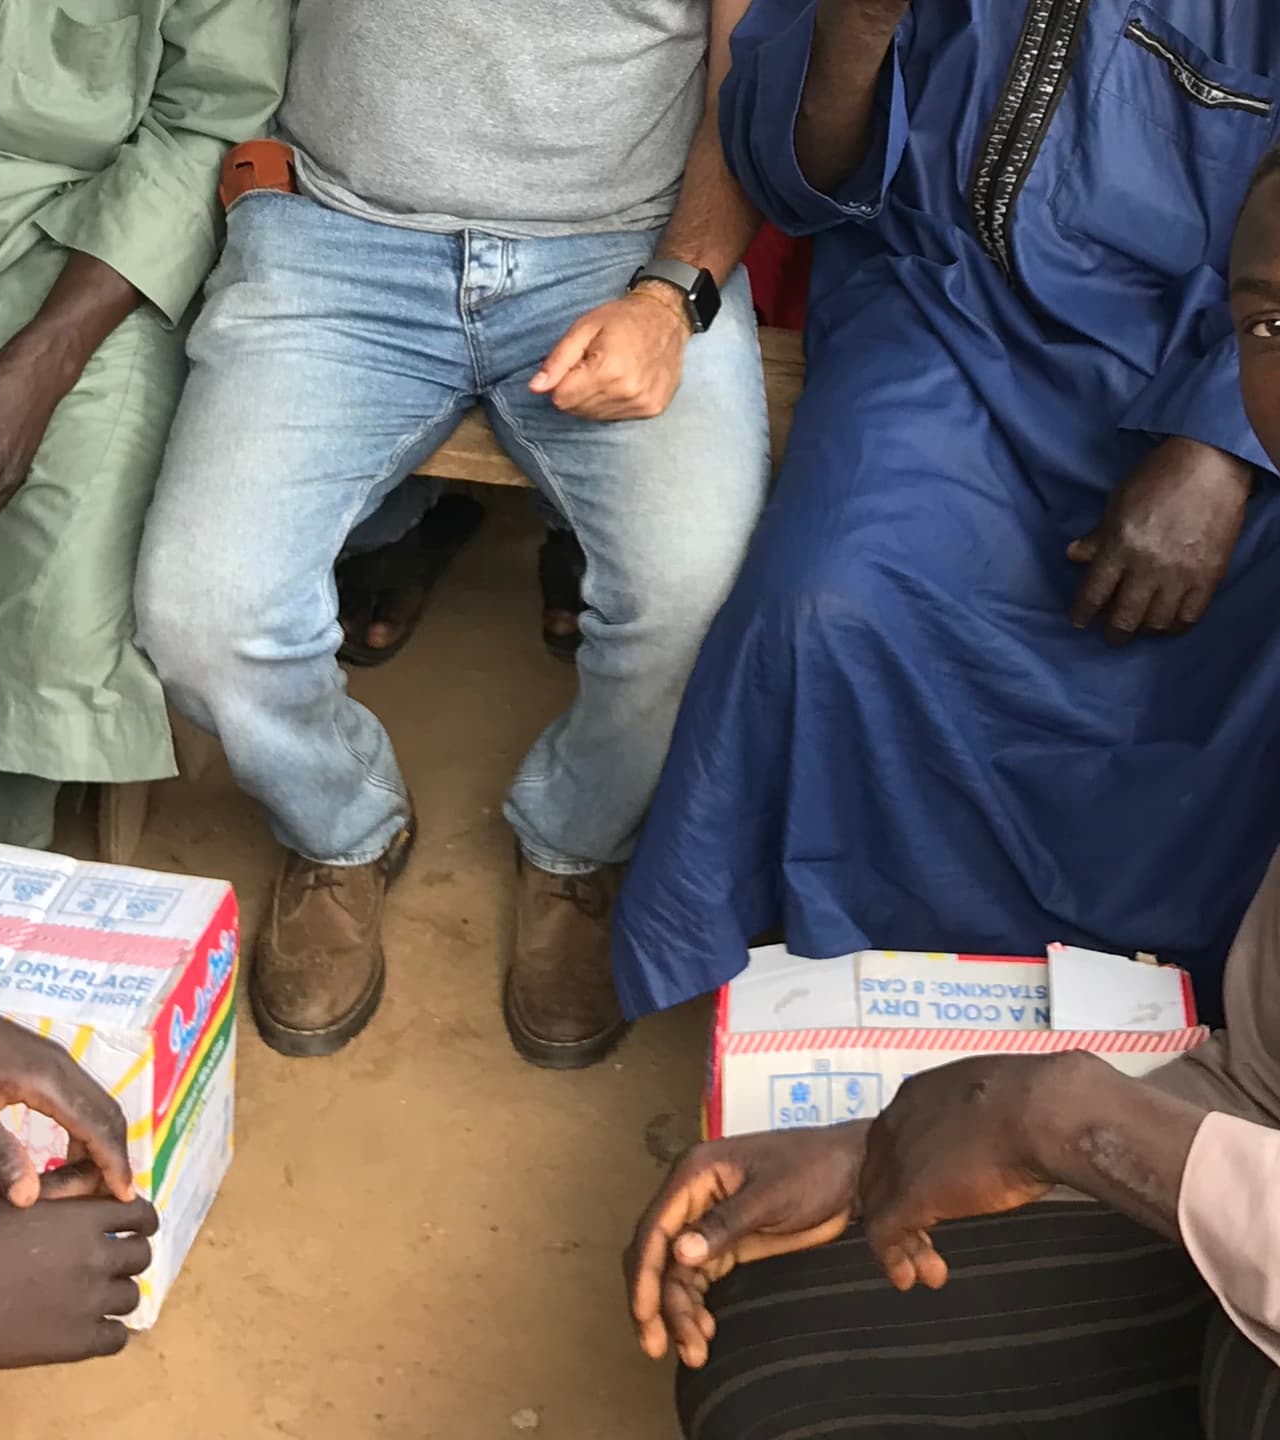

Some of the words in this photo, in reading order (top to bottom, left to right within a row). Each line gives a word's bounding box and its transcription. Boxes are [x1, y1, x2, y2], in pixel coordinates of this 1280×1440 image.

[14, 959, 65, 980] DRY
[69, 969, 156, 992] PLACE
[16, 979, 87, 1002] CASES
[91, 991, 145, 1007] HIGH
[861, 977, 907, 994] CAS
[913, 979, 925, 994] 8
[931, 981, 1049, 999] STACKING:
[867, 998, 921, 1017] DRY
[928, 1002, 1002, 1022] COOL
[1010, 1005, 1029, 1022] A
